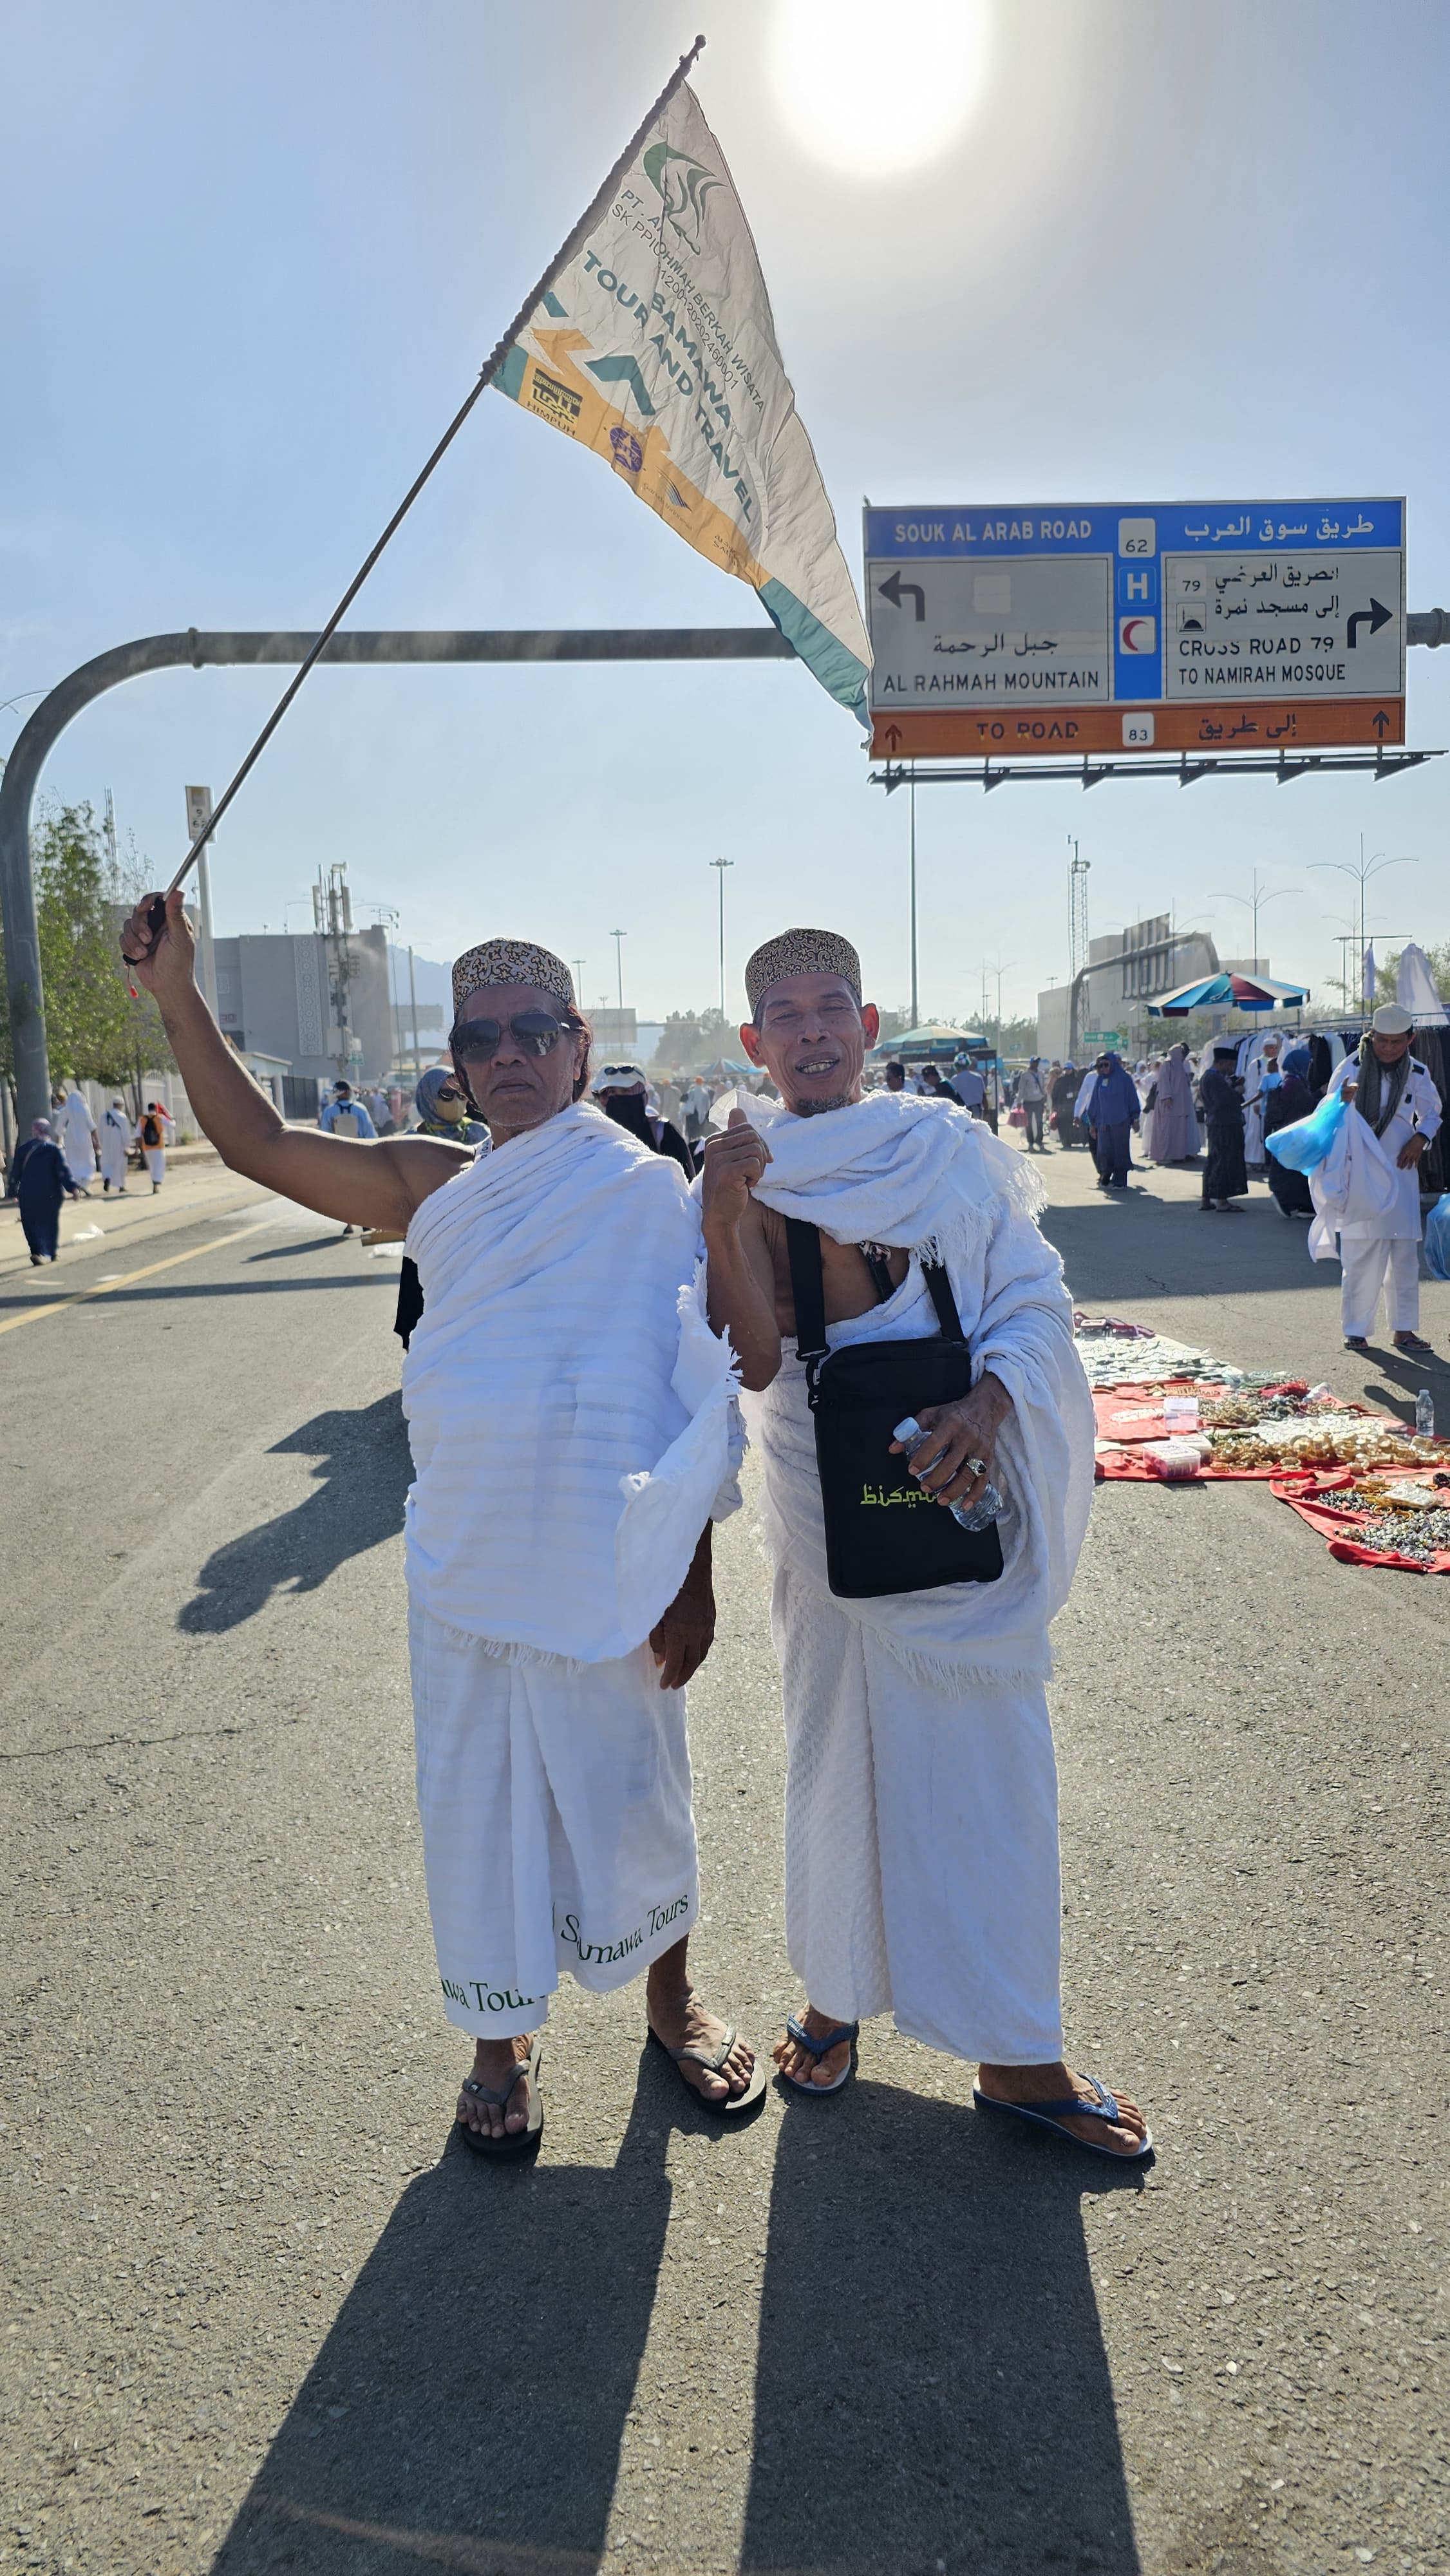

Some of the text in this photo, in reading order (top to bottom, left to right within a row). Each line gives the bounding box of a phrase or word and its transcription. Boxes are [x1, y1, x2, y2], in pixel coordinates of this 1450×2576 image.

[612, 204, 634, 226] SK
[652, 292, 731, 430] SAMAWA
[693, 293, 733, 354] BERKAH
[731, 354, 766, 413] WISATA
[583, 250, 648, 329] TOUR
[648, 333, 693, 397] AND
[695, 402, 751, 524] TRAVEL
[526, 401, 576, 437] HIMPUH
[895, 520, 1092, 543] SOUK AL ARAB ROAD
[1185, 514, 1374, 542] طريق سوق العرب
[1125, 539, 1148, 553] 62
[1127, 572, 1148, 600] H
[1182, 580, 1201, 592] 79
[1215, 595, 1339, 620] إلى مسجد نمرة
[934, 632, 1059, 658] جبل الرحمة
[1180, 636, 1335, 656] CROSS ROAD 79
[883, 670, 1099, 692] AL RAHMAH MOUNTAIN
[1179, 664, 1346, 685] TO NAMIRAH MOSQUE
[977, 721, 1079, 740] TO ROAD
[1129, 729, 1148, 741] 83
[1199, 713, 1297, 741] إلى طريق
[647, 1895, 688, 1937] Tours
[441, 1978, 546, 2012] wa Tou
